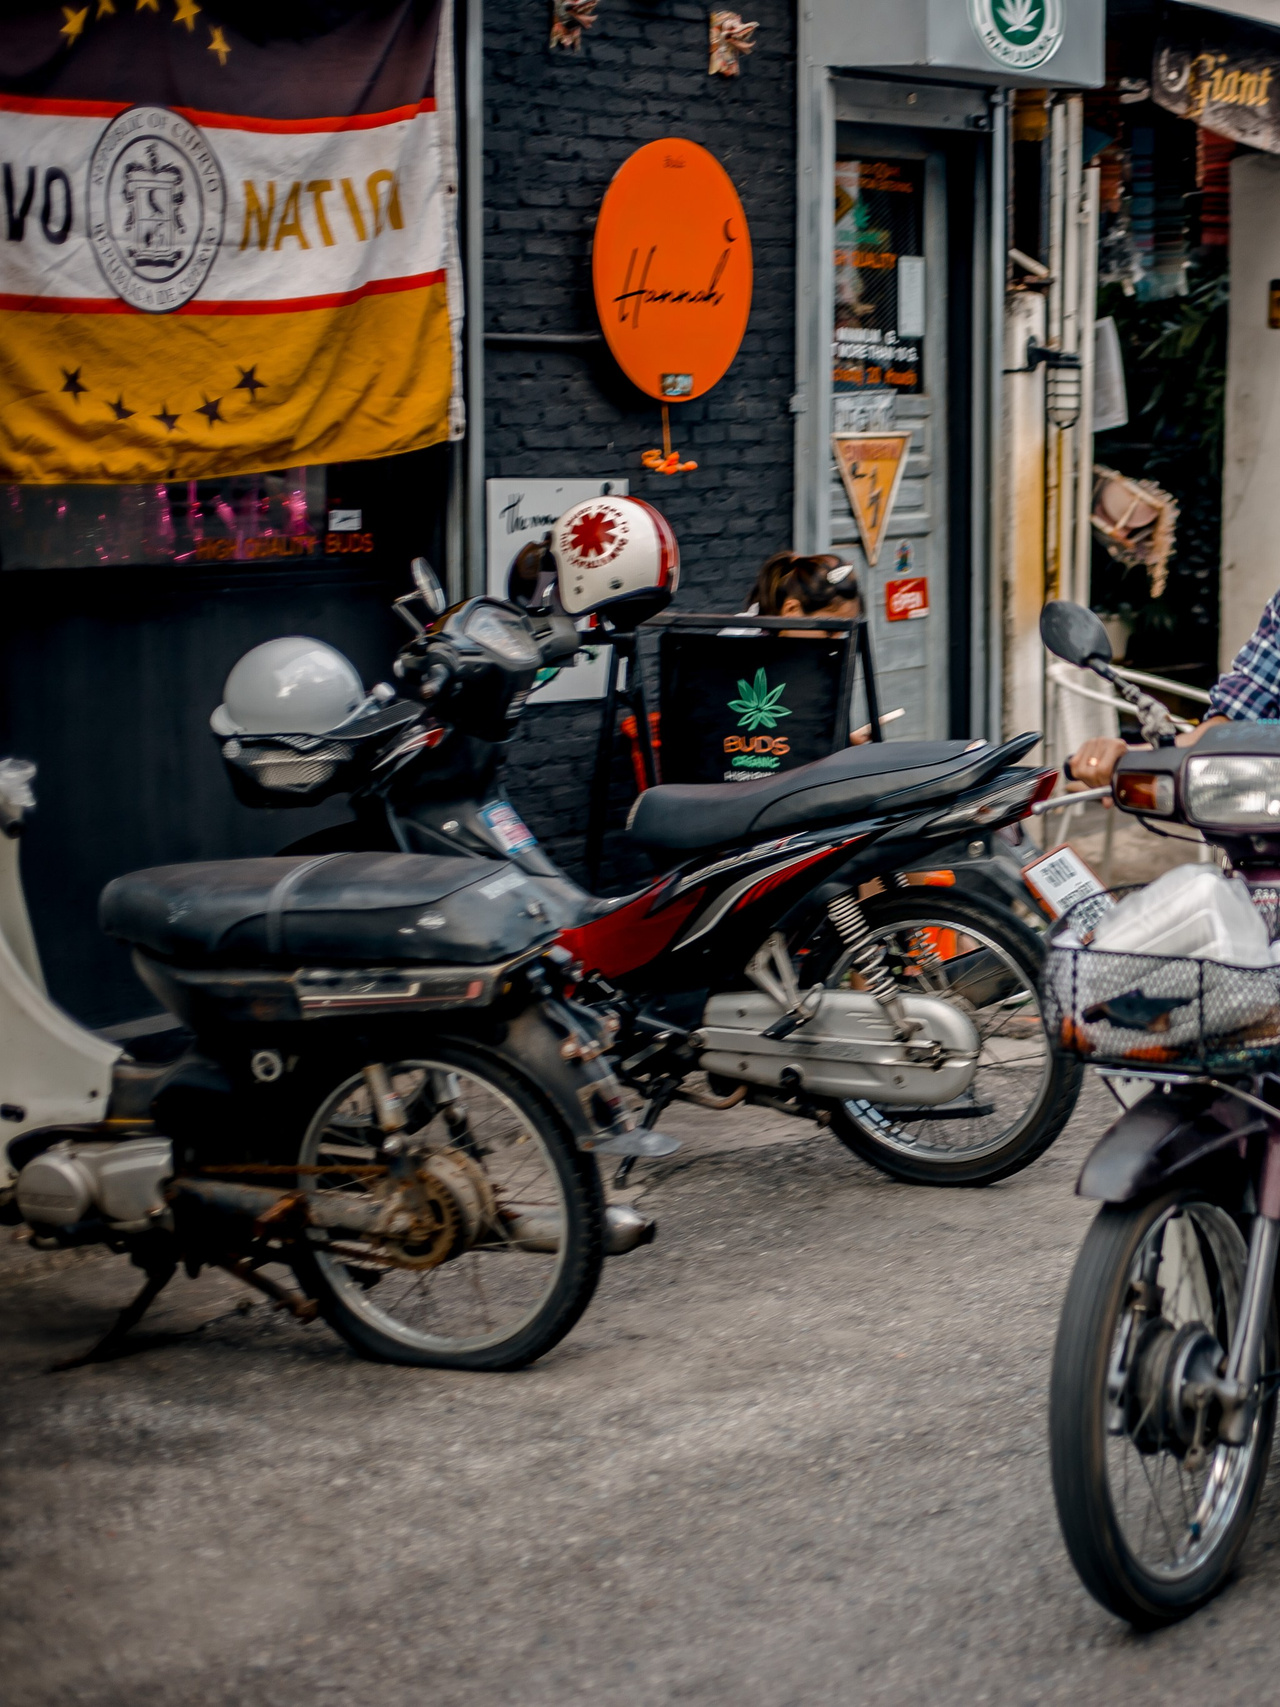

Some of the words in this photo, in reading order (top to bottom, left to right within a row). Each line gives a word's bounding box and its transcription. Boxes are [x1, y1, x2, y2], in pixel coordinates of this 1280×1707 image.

[1185, 54, 1273, 118] Giant
[325, 532, 374, 554] BUDS
[723, 735, 791, 755] BUDS
